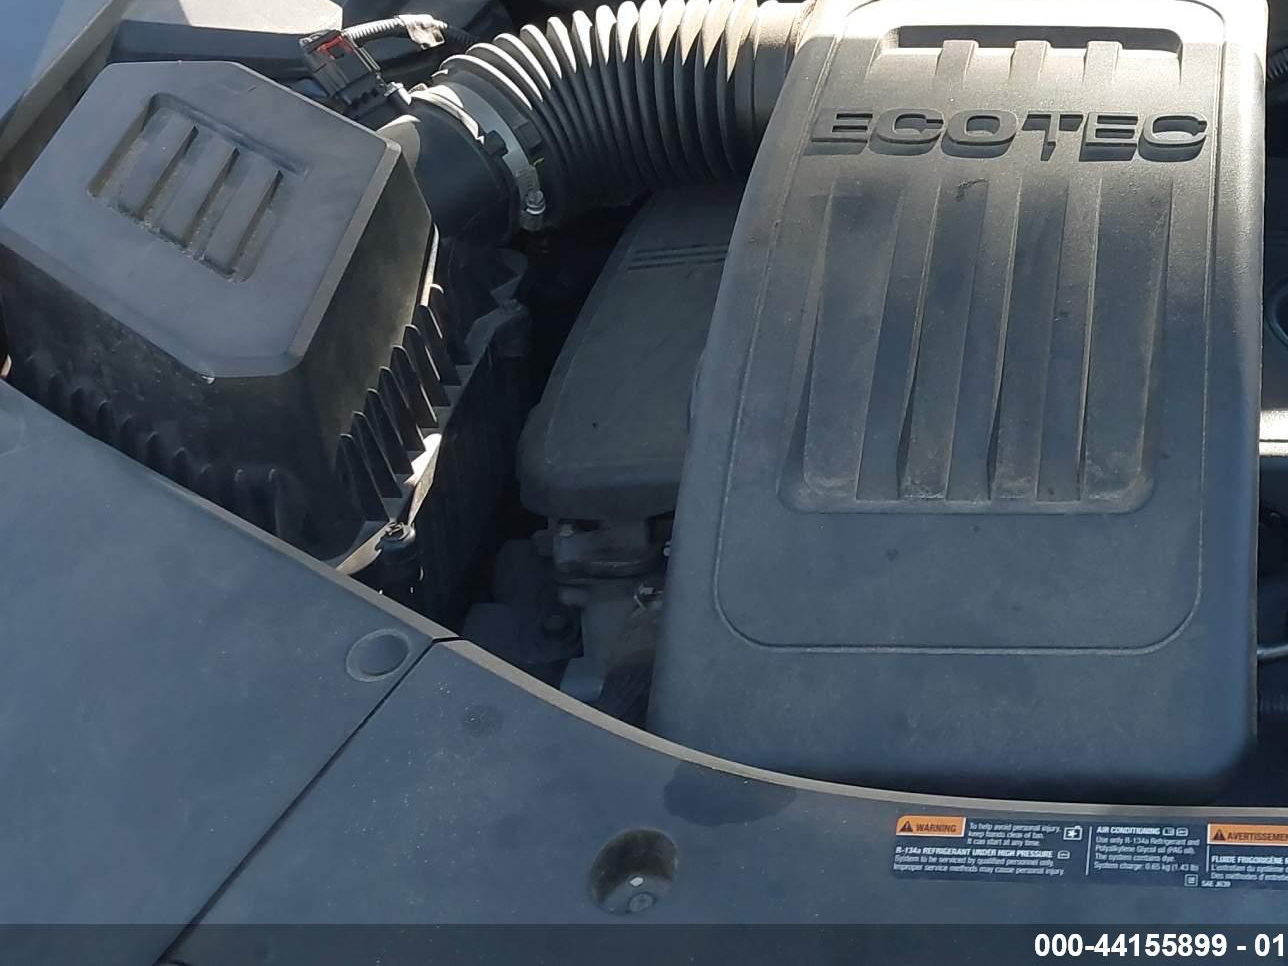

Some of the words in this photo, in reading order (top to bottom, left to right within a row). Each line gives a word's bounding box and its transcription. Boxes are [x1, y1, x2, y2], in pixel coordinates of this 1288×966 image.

[807, 108, 1208, 159] ECOTEC
[916, 823, 956, 832] WARNING
[922, 848, 970, 856] REFRIGERANT
[1016, 850, 1052, 858] PRESSURE
